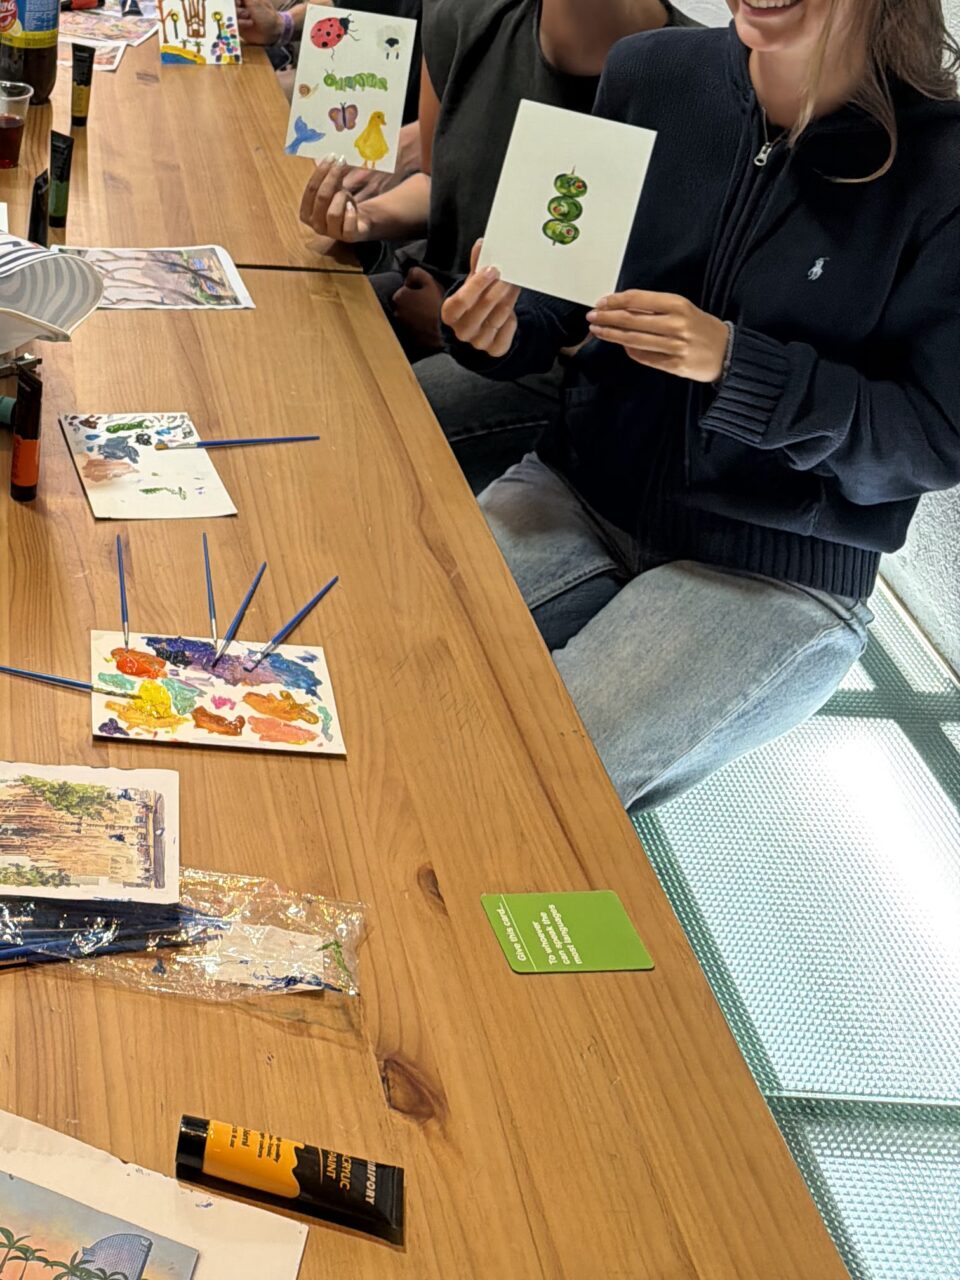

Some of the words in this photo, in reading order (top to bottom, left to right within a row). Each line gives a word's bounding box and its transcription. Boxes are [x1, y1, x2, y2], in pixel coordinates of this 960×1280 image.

[540, 912, 551, 926] the
[548, 904, 572, 942] languages
[506, 925, 519, 943] this
[532, 921, 554, 955] whoever
[546, 926, 563, 950] speak
[514, 942, 527, 962] Give
[547, 954, 558, 965] To
[558, 950, 570, 965] can
[567, 941, 582, 965] most
[364, 1160, 377, 1205] INSPORY
